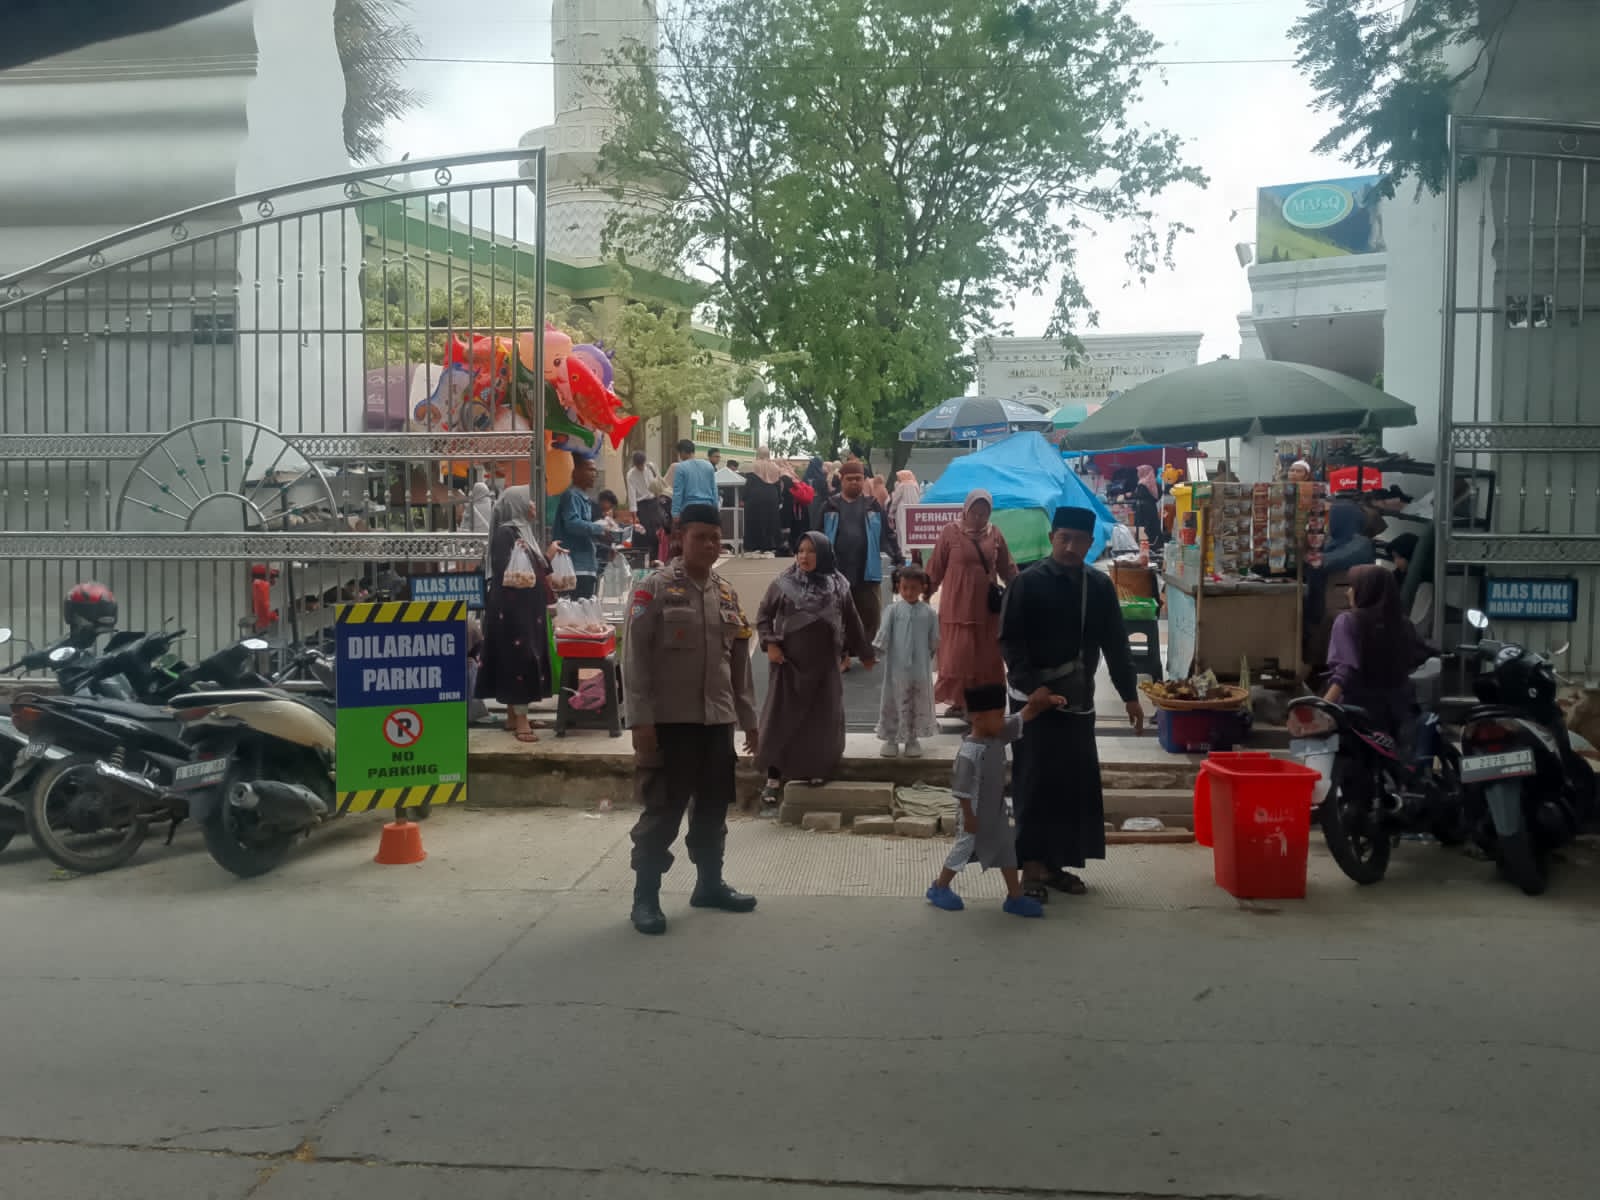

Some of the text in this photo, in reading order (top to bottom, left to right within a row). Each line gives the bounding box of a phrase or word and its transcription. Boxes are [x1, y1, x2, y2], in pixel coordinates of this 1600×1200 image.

[415, 576, 479, 593] ALAS KAKI
[1492, 583, 1568, 600] ALAS KAKI
[1489, 601, 1569, 614] HARAP DILEPAS
[347, 633, 456, 660] DILARANG
[362, 666, 442, 692] PARKIR
[391, 752, 414, 763] NO
[367, 763, 438, 779] PARKING
